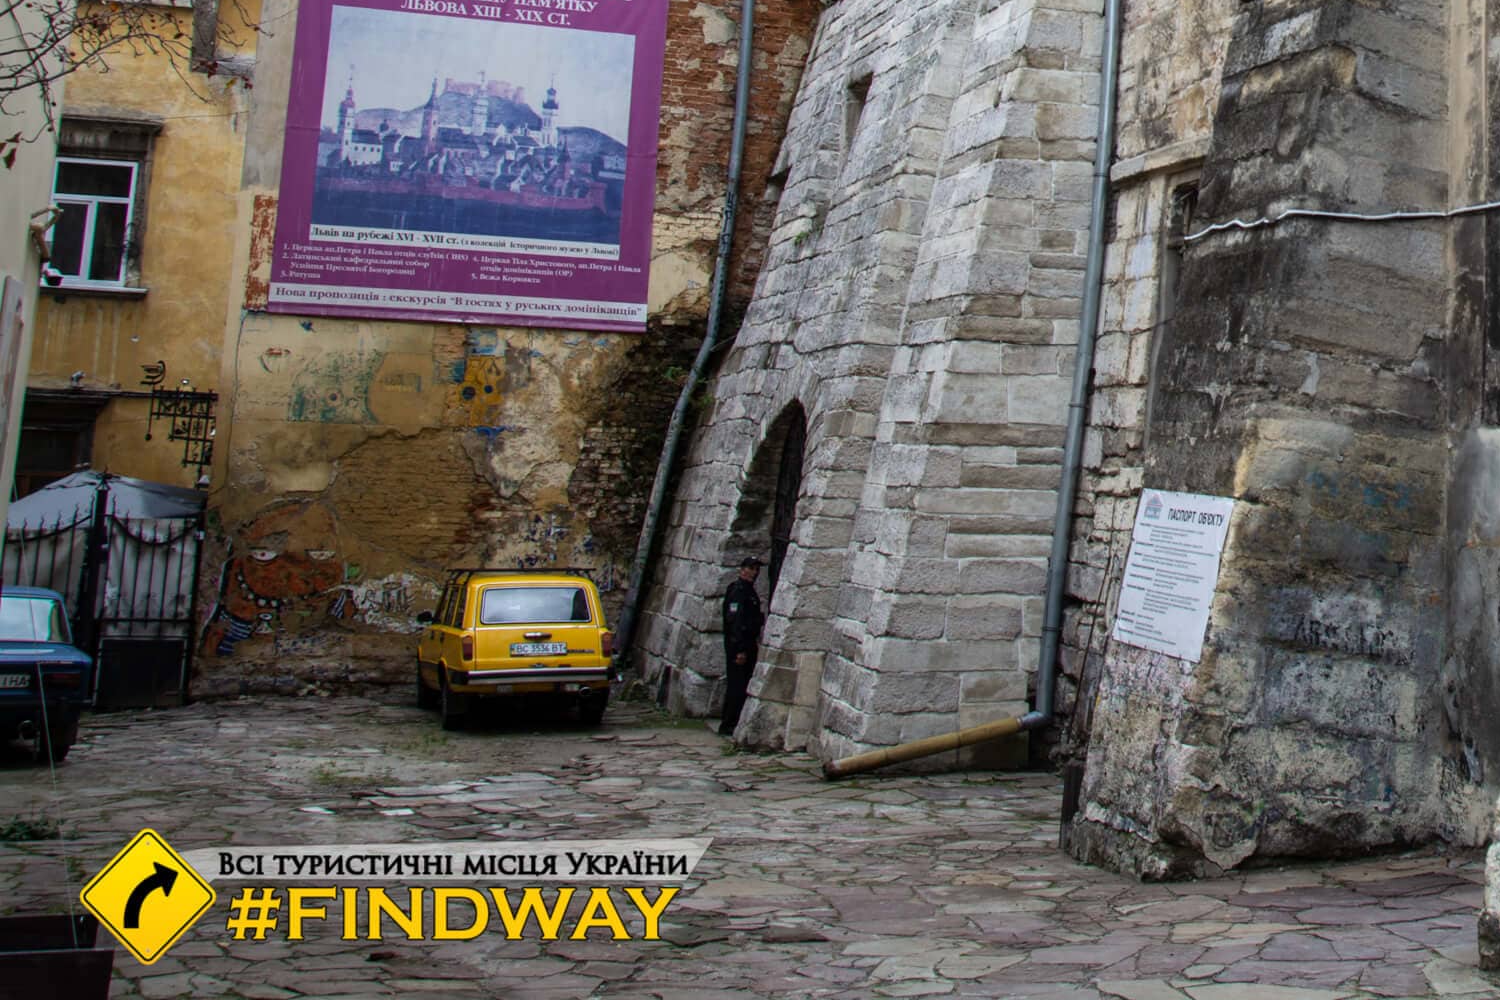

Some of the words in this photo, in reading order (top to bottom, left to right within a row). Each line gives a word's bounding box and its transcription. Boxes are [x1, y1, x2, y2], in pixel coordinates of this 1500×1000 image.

[547, 12, 572, 26] СТ.
[313, 227, 340, 237] Львів
[342, 230, 355, 238] на
[357, 230, 394, 241] рубежі
[446, 237, 460, 245] ст.
[275, 287, 306, 297] Нова
[310, 289, 380, 301] пропозиція
[389, 294, 447, 306] екскурсія
[465, 299, 503, 308] гостях
[505, 301, 512, 310] у
[515, 302, 561, 311] руських
[1168, 508, 1197, 523] ПАСПОРТ
